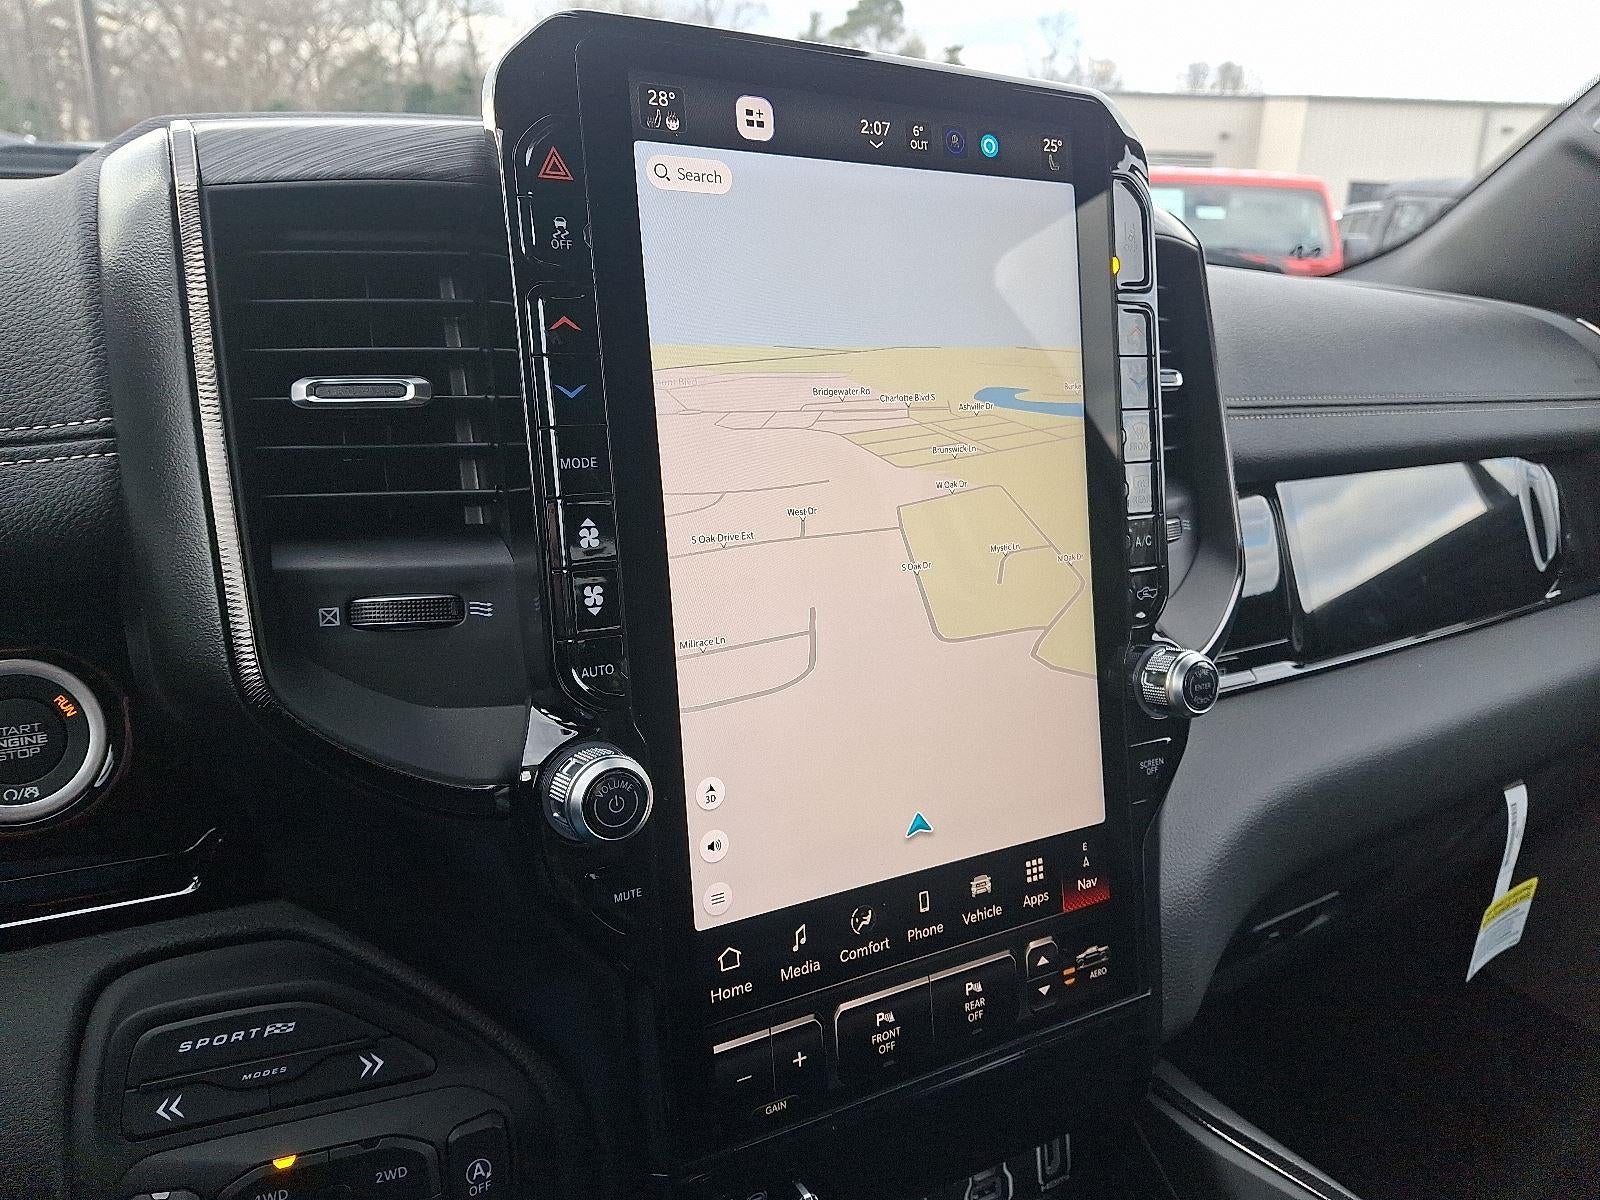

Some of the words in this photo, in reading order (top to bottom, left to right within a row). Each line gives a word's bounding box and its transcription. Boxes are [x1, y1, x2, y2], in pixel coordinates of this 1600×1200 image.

[647, 89, 676, 107] 28°
[860, 119, 891, 136] 2:07
[912, 125, 924, 137] 6°
[910, 139, 929, 151] OUT
[1043, 138, 1063, 153] 25°
[677, 167, 723, 184] Search
[551, 239, 573, 250] OFF
[812, 387, 858, 398] Bridgewater
[879, 394, 913, 403] Charlotte
[958, 402, 983, 411] Ashville
[983, 402, 993, 410] Dr
[932, 445, 967, 454] Brunswick
[968, 445, 977, 453] Ln
[560, 457, 599, 470] MODE
[936, 481, 943, 489] W
[944, 480, 958, 488] Oak
[958, 480, 968, 488] Dr
[787, 507, 807, 517] West
[807, 506, 818, 516] Dr
[691, 535, 697, 544] S
[699, 534, 715, 543] Oak
[717, 532, 740, 543] Drive
[741, 531, 754, 541] Ext
[1135, 534, 1152, 548] A/C
[990, 544, 1012, 554] Mystic
[901, 563, 907, 572] S
[907, 562, 922, 571] Oak
[922, 561, 932, 570] Dr
[679, 638, 714, 650] Millrace
[715, 636, 726, 645] Ln
[581, 664, 615, 679] AUTO
[53, 694, 78, 718] RUN
[0, 723, 42, 737] TART
[0, 734, 48, 748] NGINE
[1139, 756, 1165, 770] SCREEN
[595, 780, 634, 799] VOLUME
[705, 794, 717, 804] 3D
[1077, 876, 1098, 891] Nav
[613, 887, 643, 904] MUTE
[1022, 891, 1050, 908] Apps
[962, 904, 1003, 925] Vehicle
[907, 922, 944, 942] Phone
[839, 937, 890, 963] Comfort
[780, 959, 821, 982] Media
[1089, 966, 1108, 980] AERO
[710, 981, 753, 1004] Home
[964, 997, 986, 1012] REAR
[967, 1009, 984, 1023] OFF
[178, 1027, 262, 1053] SPORT
[871, 1026, 901, 1045] FRONT
[878, 1040, 897, 1055] OFF
[241, 1066, 287, 1081] MODES
[765, 1100, 787, 1115] GAIN
[375, 1166, 408, 1183] 2WD
[469, 1180, 492, 1197] OFF
